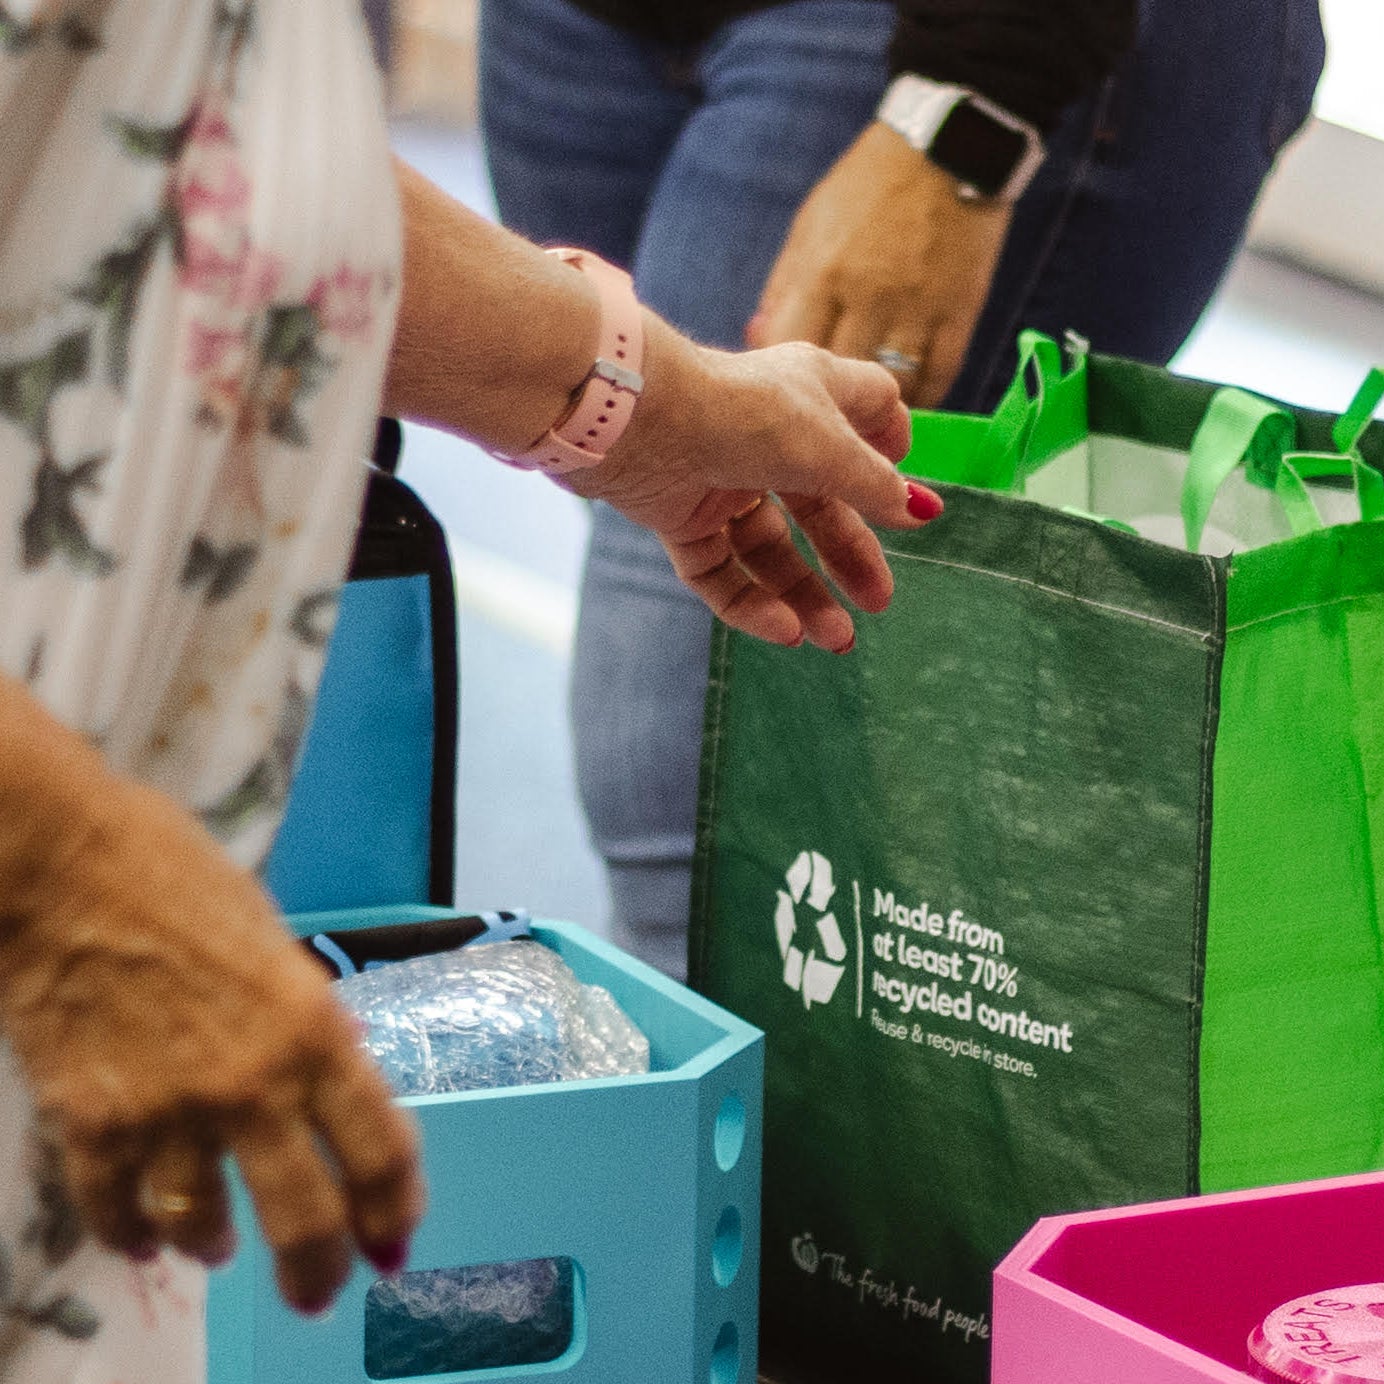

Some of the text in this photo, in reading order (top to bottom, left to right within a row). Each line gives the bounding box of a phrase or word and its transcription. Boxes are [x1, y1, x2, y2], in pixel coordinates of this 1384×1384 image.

[873, 888, 1004, 955] Made from
[873, 933, 1018, 998] at least 70%
[871, 1008, 1038, 1078] Reuse & recycle in store.
[873, 971, 1073, 1052] recycled content
[821, 1253, 990, 1343] The fresh food people
[1283, 1298, 1362, 1364] TREATS
